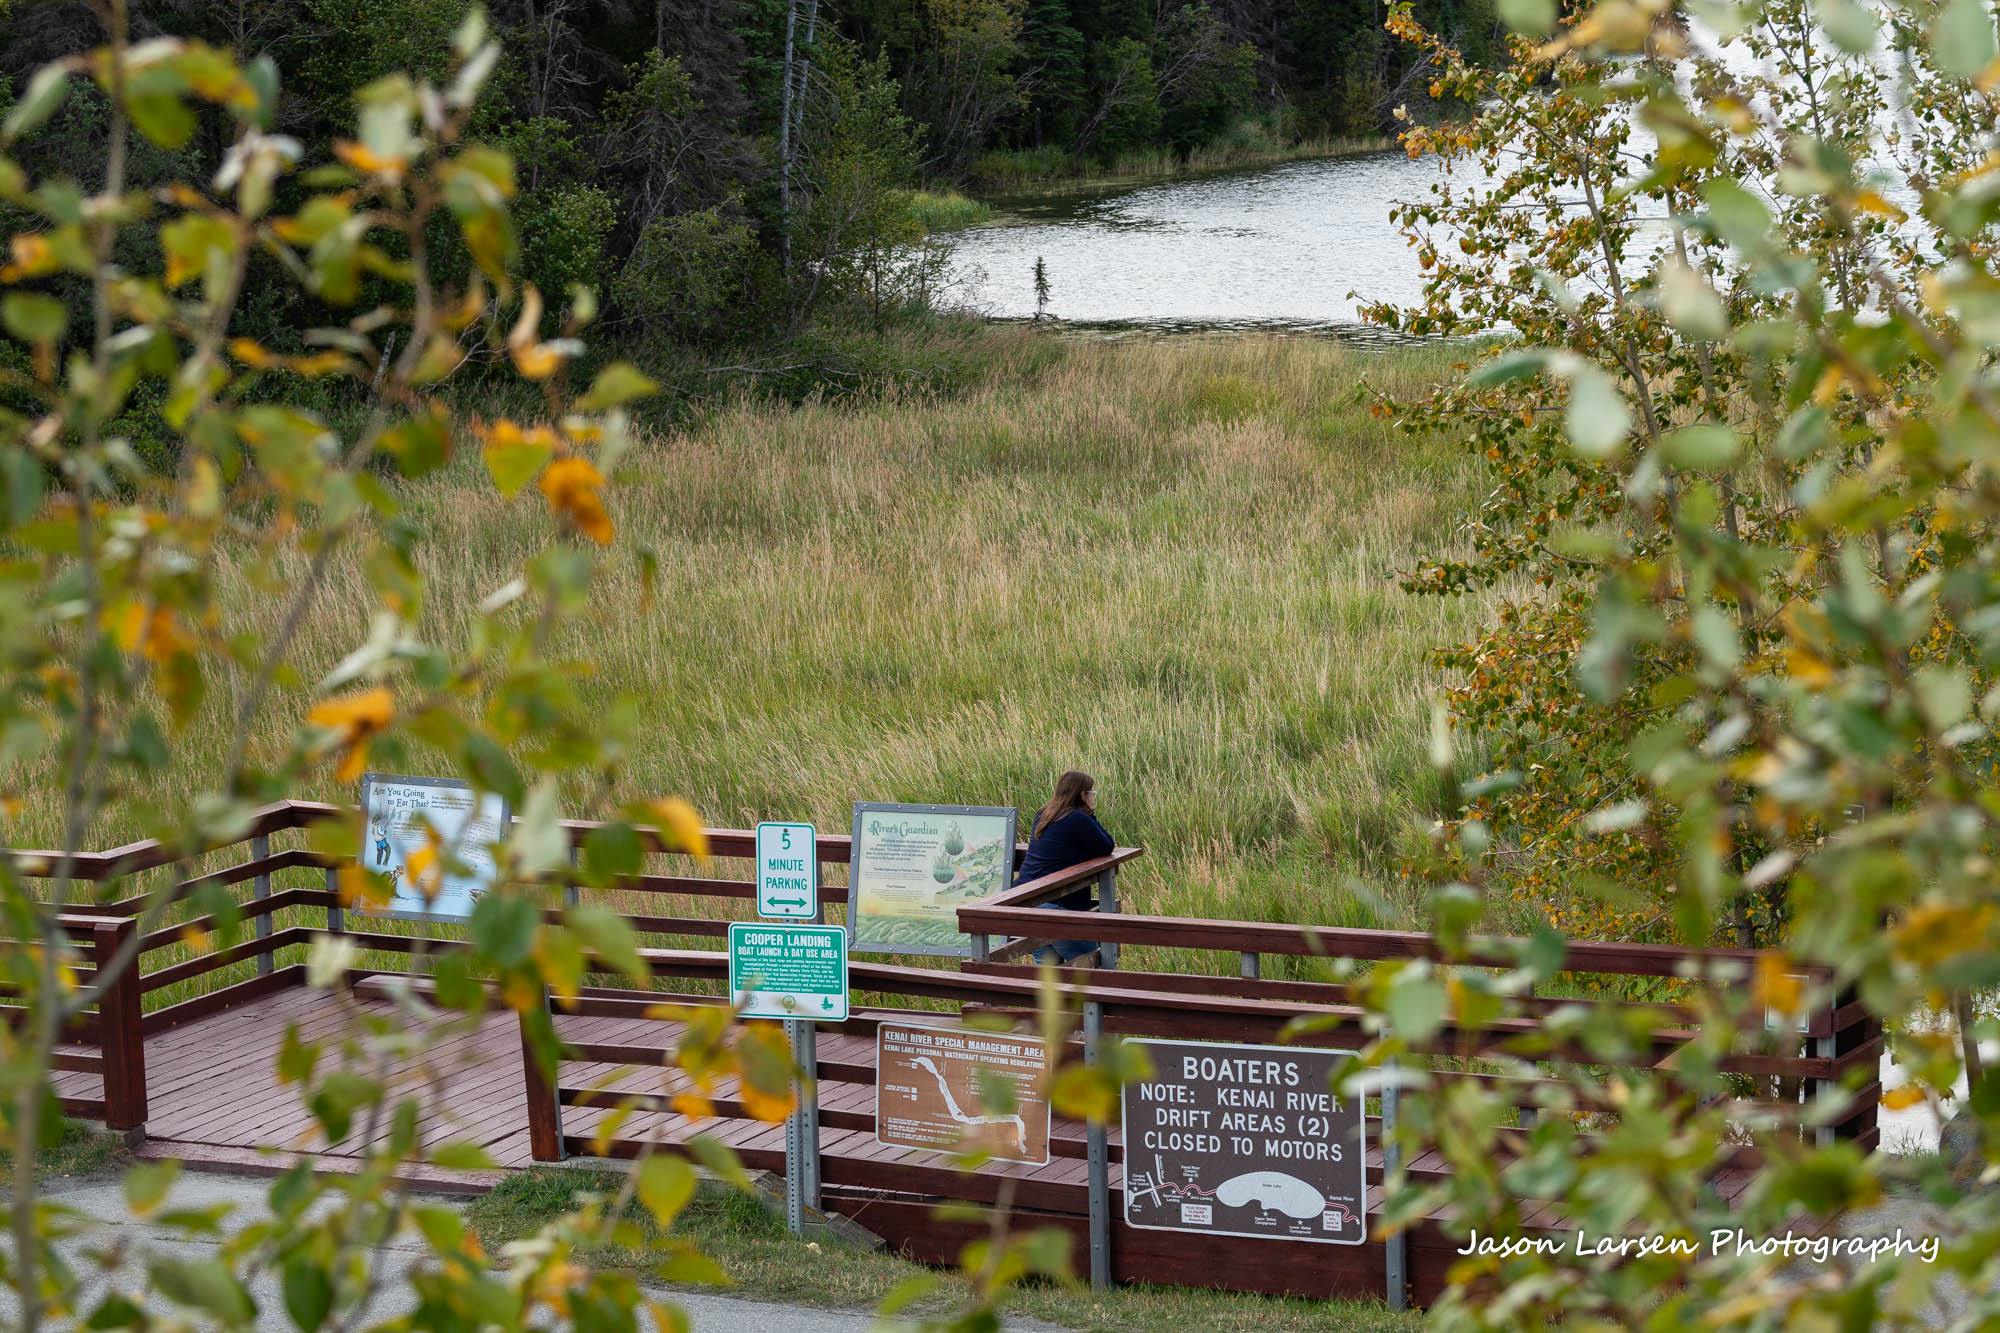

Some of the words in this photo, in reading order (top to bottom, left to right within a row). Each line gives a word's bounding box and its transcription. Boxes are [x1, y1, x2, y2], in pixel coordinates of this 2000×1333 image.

[373, 787, 385, 796] Are
[387, 788, 401, 797] You
[403, 789, 425, 799] Going
[396, 798, 408, 807] Eat
[410, 799, 430, 808] That?
[870, 820, 899, 836] River's
[899, 820, 939, 838] Guardian
[781, 833, 791, 850] 5
[768, 858, 805, 871] MINUTE
[766, 877, 808, 891] PARKING
[744, 932, 784, 946] COOPER
[787, 934, 832, 948] LANDING
[738, 946, 754, 956] BOAT
[756, 947, 782, 957] LAUNCH
[784, 948, 789, 957] &
[791, 948, 803, 958] DAY
[806, 949, 818, 958] USE
[821, 949, 838, 959] AREA
[884, 1030, 908, 1042] KENAI
[910, 1033, 932, 1045] RIVER
[934, 1036, 966, 1049] SPECIAL
[968, 1040, 1023, 1055] MANAGEMENT
[1024, 1047, 1045, 1058] AREA
[884, 1044, 900, 1052] KENAI
[901, 1046, 915, 1054] LAKE
[916, 1048, 942, 1057] PERSONAL
[944, 1051, 979, 1062] WATERCRAFT
[980, 1055, 1009, 1065] OPERATING
[1009, 1058, 1045, 1069] REGULATIONS
[1183, 1056, 1300, 1086] BOATERS
[1140, 1083, 1195, 1104] NOTE:
[1217, 1087, 1275, 1109] KENAI
[1286, 1091, 1344, 1113] RIVER
[1156, 1108, 1211, 1129] DRIFT
[1220, 1112, 1286, 1134] AREAS
[1298, 1116, 1329, 1138] (2)
[1144, 1131, 1221, 1153] CLOSED
[1231, 1136, 1253, 1156] TO
[1265, 1139, 1343, 1162] MOTORS
